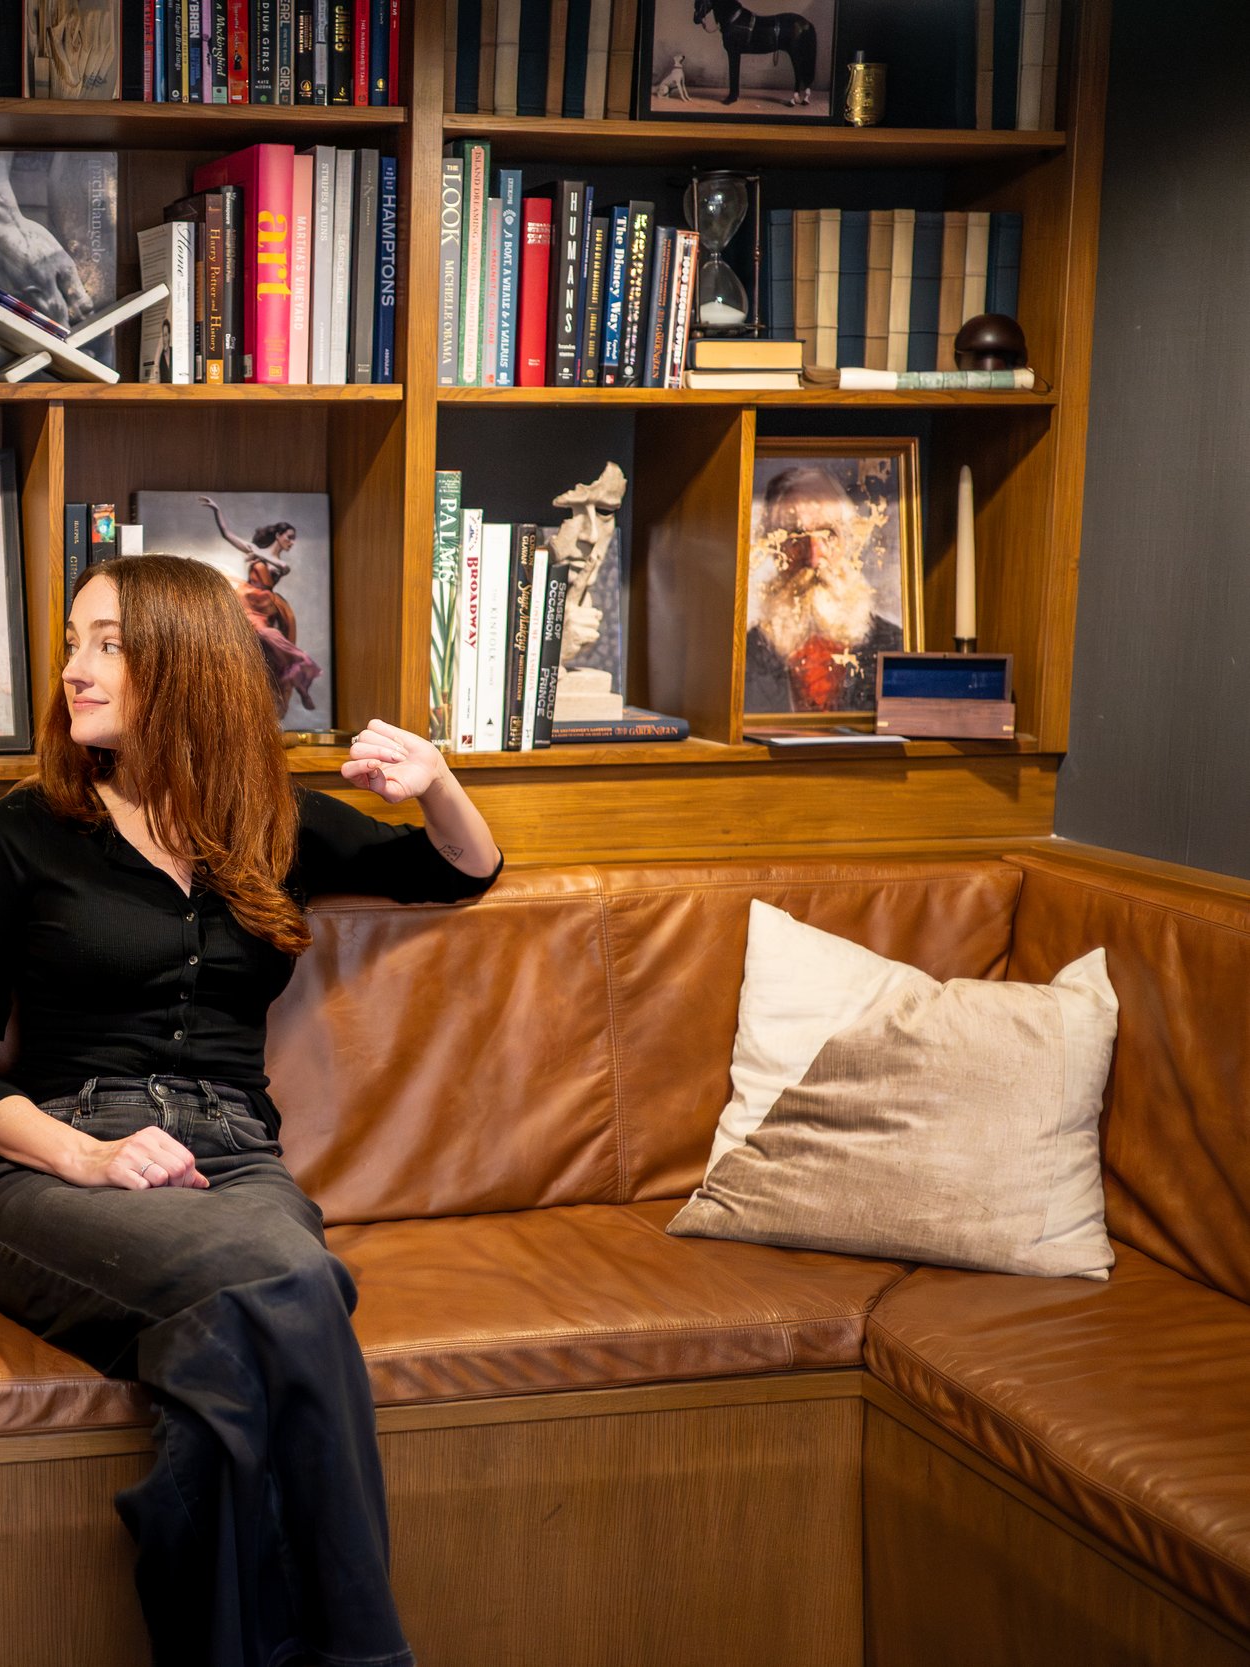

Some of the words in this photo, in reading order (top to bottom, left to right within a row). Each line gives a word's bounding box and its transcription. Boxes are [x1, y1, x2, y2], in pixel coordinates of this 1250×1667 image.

[190, 0, 199, 38] 'BRIEN
[212, 15, 226, 76] Mockingbird
[280, 66, 290, 94] GIRL
[321, 163, 329, 203] STRIPES
[473, 150, 482, 186] ISLAND
[441, 173, 461, 246] LOOK
[472, 187, 480, 238] DREAMING
[615, 217, 627, 244] The
[209, 228, 221, 262] Harry
[257, 210, 291, 301] art
[296, 215, 307, 271] MARTHA'S
[381, 194, 395, 306] HAMPTONS
[565, 192, 578, 333] HUMANS
[209, 266, 221, 298] Potter
[443, 260, 454, 320] MICHELLE
[610, 248, 625, 297] Disney
[682, 256, 690, 283] 1000
[294, 276, 305, 330] VINEYARD
[502, 276, 511, 309] WHALE
[678, 284, 688, 324] RECORD
[210, 315, 222, 352] History
[502, 320, 508, 328] A
[607, 302, 621, 332] Way
[442, 322, 453, 364] OBAMA
[500, 330, 508, 367] WALRUS
[438, 497, 459, 584] PALMS
[464, 556, 478, 650] BROADWAY
[518, 581, 532, 608] Stage
[545, 579, 559, 641] OCCASION
[554, 582, 567, 621] SENSE
[488, 607, 498, 662] KINFOLK
[514, 609, 530, 652] Makeup
[554, 624, 563, 640] OF
[537, 667, 550, 717] PRINCE
[546, 665, 559, 721] HAROLD
